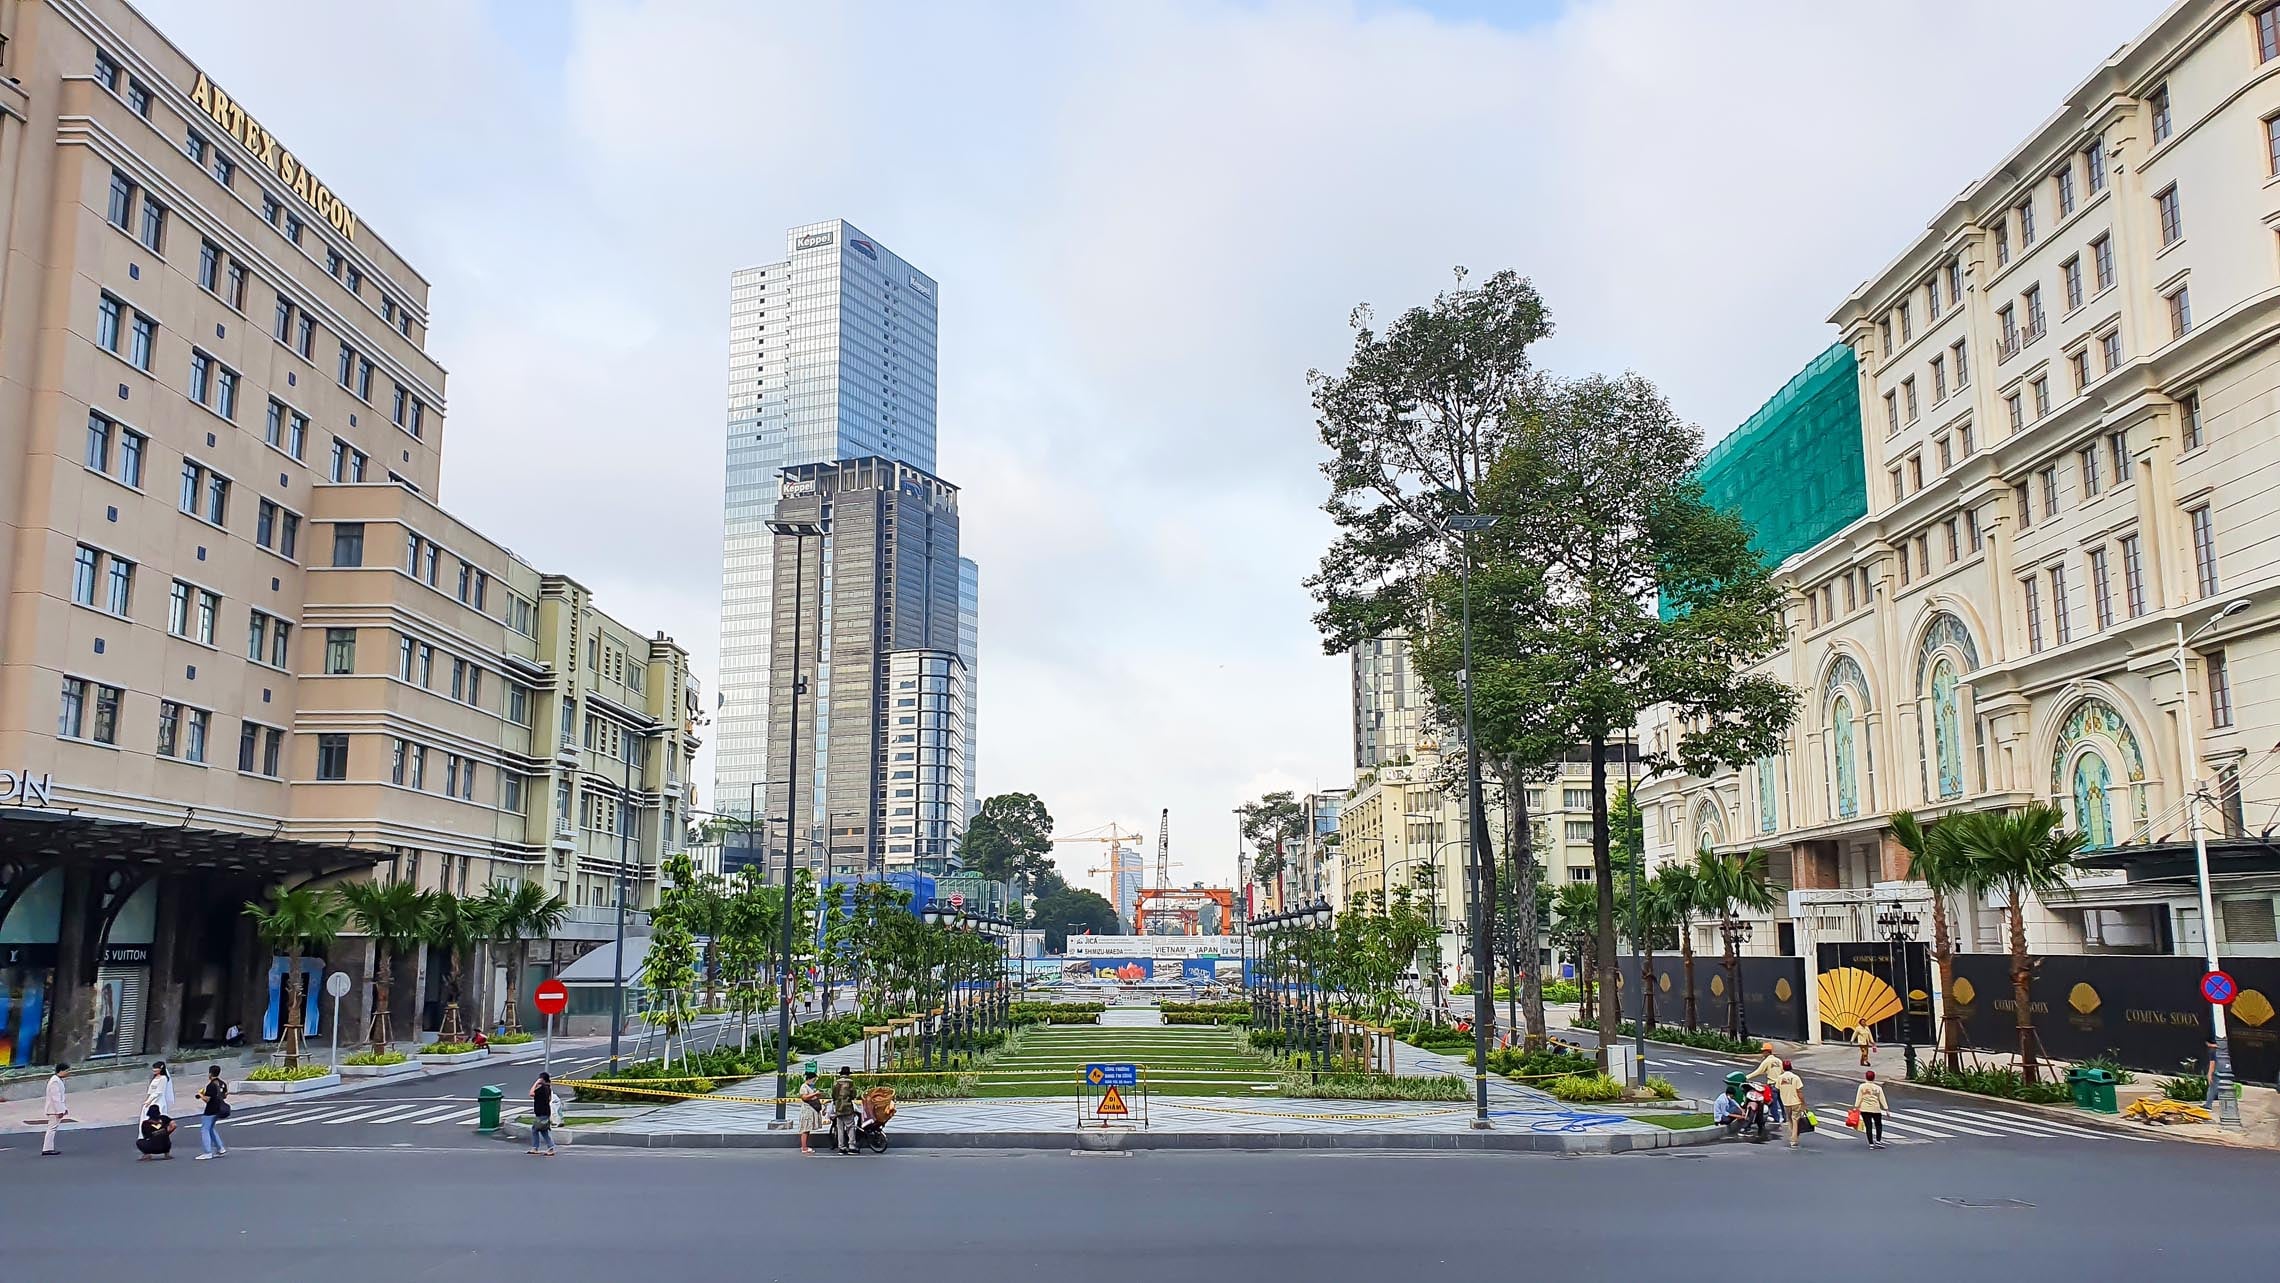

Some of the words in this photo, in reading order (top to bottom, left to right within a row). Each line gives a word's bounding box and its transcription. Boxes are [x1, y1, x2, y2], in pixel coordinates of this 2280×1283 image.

[191, 72, 275, 171] ARTEX
[280, 151, 358, 243] SAIGON
[797, 233, 832, 248] Keppel
[783, 482, 813, 494] Keppel
[112, 949, 147, 961] VUITTON
[2126, 1008, 2167, 1023] COMING
[2170, 1012, 2200, 1026] SOON
